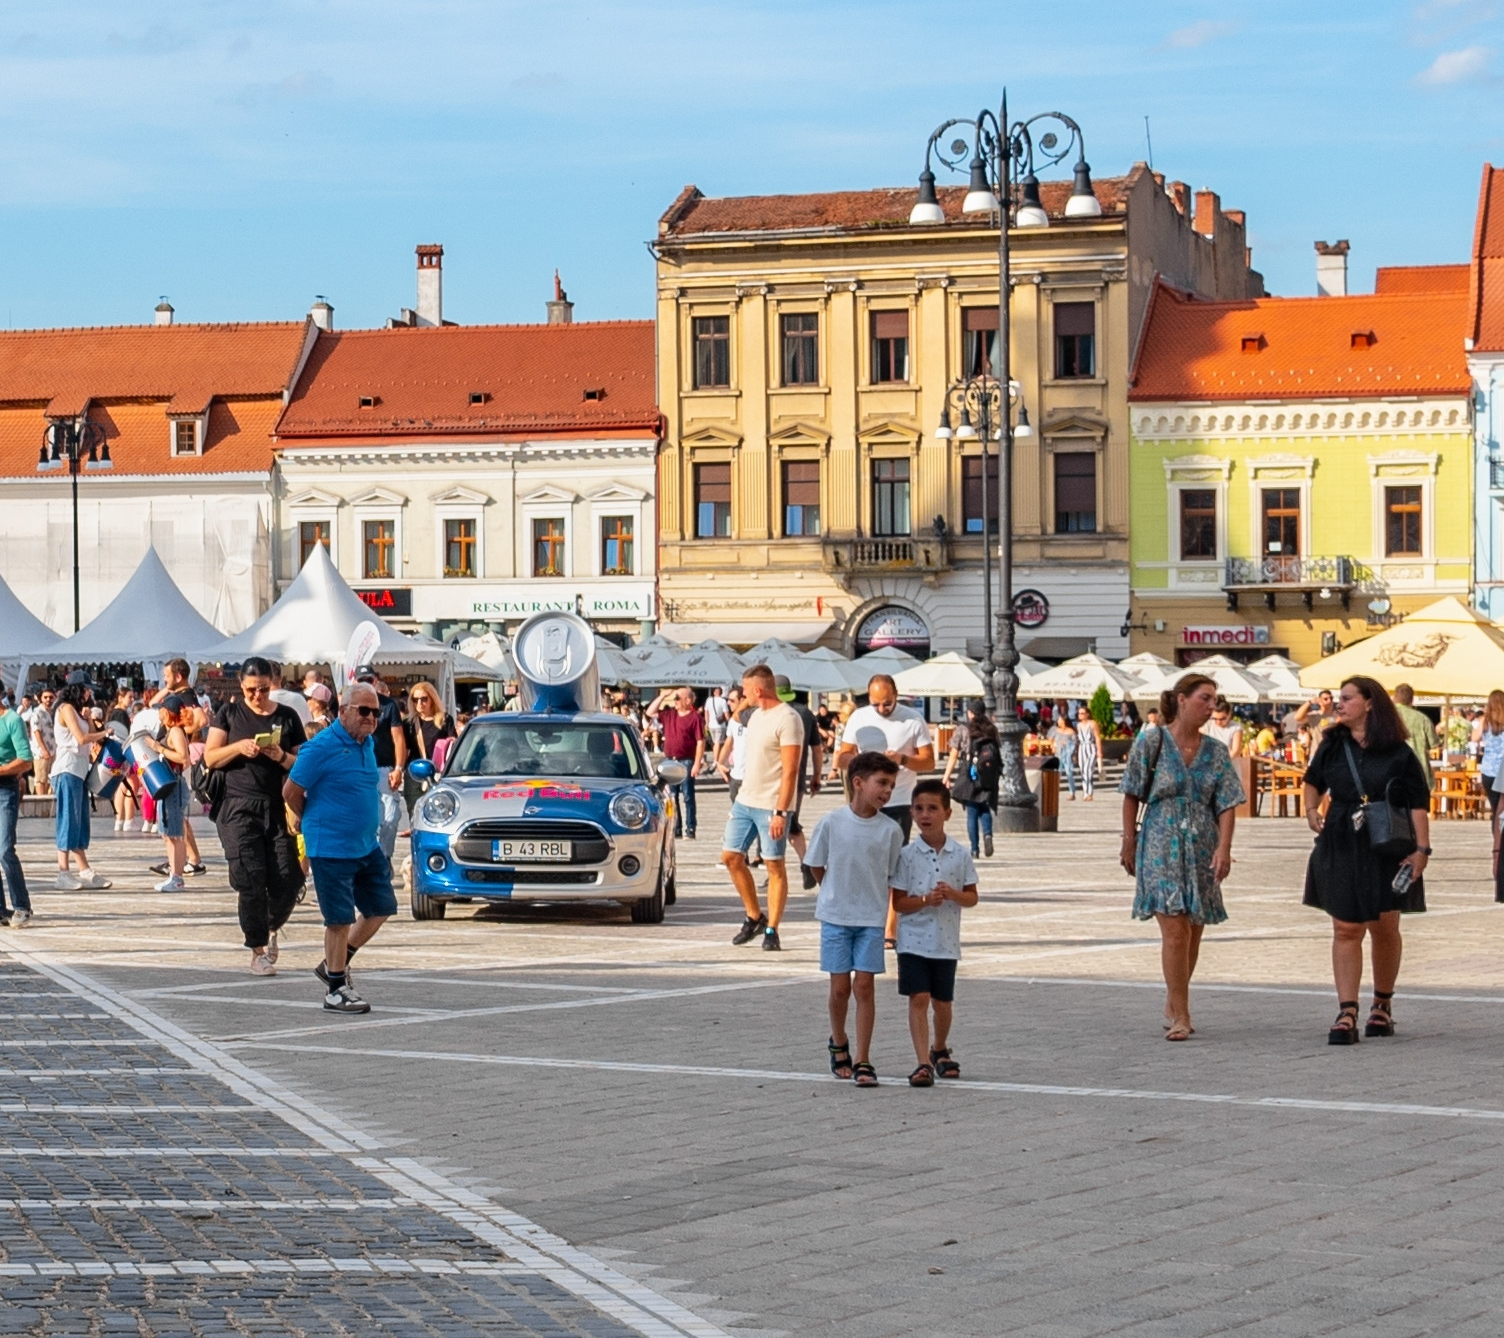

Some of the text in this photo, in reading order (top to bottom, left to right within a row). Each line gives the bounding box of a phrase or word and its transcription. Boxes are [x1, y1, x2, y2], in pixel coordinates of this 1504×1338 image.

[473, 600, 640, 612] RESTAURANT ROMA
[883, 618, 903, 626] ART
[483, 788, 591, 800] Red Bull
[503, 843, 568, 855] B 43 RBL
